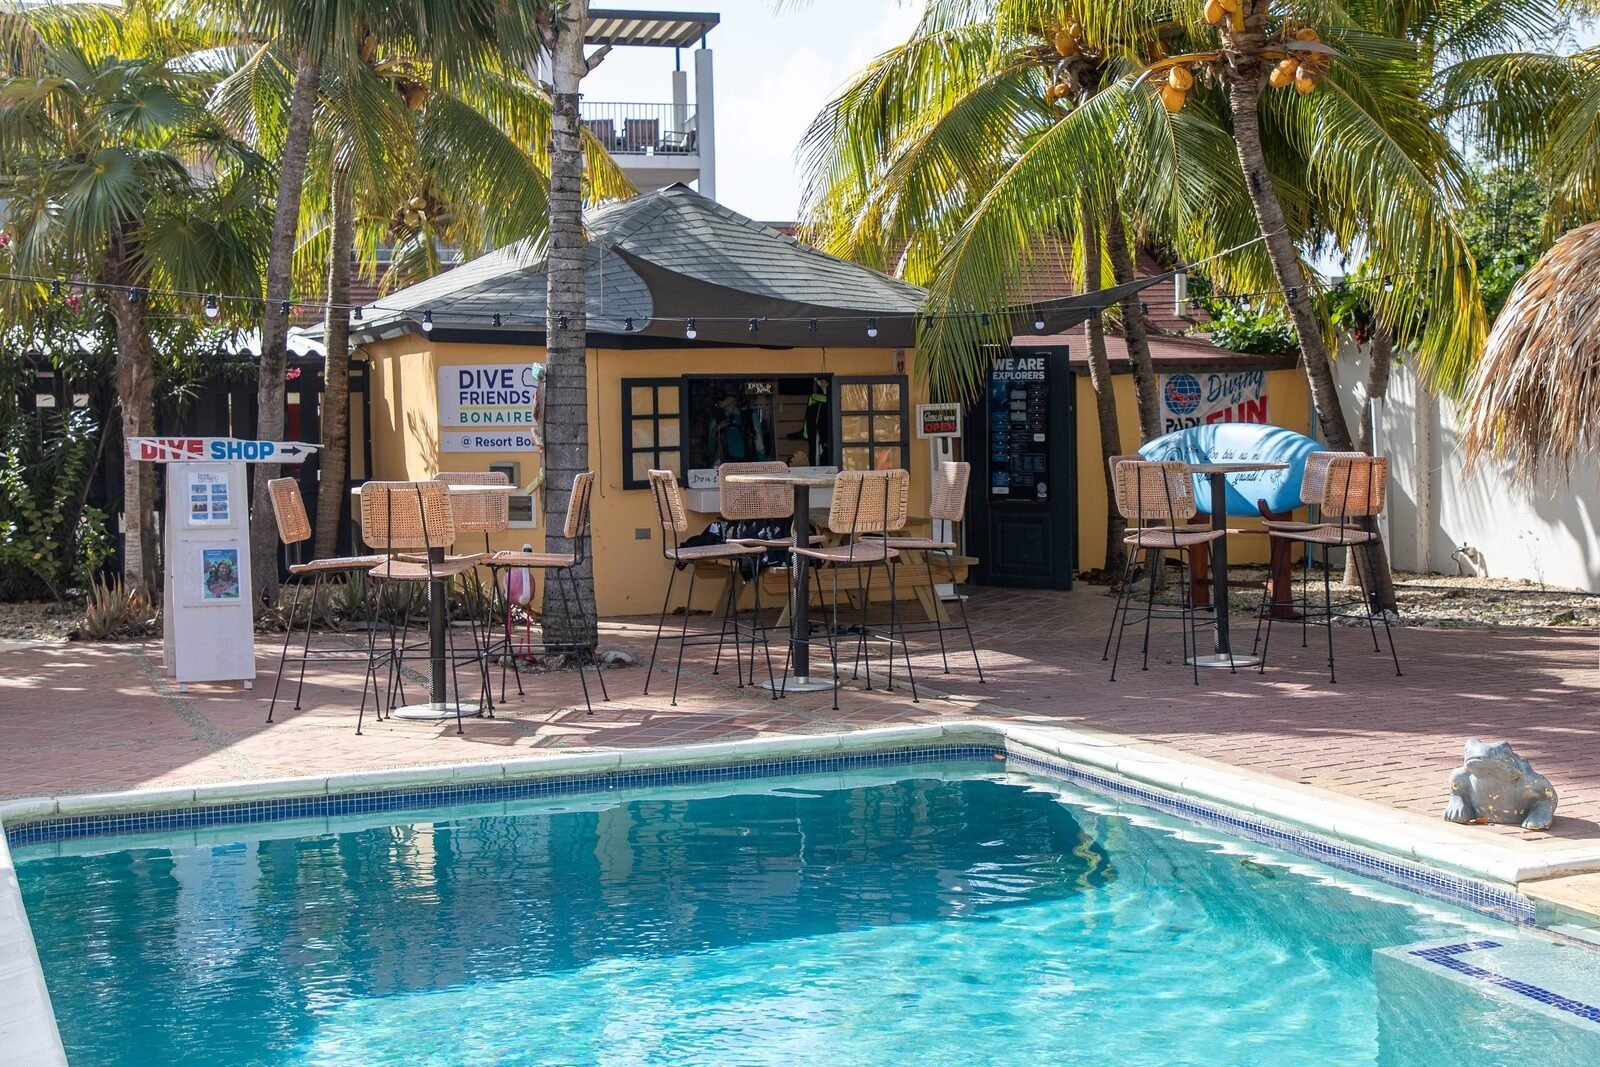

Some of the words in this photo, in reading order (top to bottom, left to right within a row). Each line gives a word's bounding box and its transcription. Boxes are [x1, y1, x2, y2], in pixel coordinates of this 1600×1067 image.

[994, 358, 1014, 371] WE
[1017, 358, 1045, 371] ARE
[459, 369, 514, 389] DIVE
[992, 371, 1045, 380] EXPLORERS
[1206, 370, 1264, 402] Diving
[459, 390, 531, 405] FRIENDS
[460, 411, 533, 423] BONAIRE
[924, 422, 955, 432] OPEN
[461, 436, 471, 448] @
[475, 437, 512, 447] Resort
[516, 437, 535, 447] Bo
[141, 439, 204, 460] DIVE
[210, 441, 275, 460] SHOP
